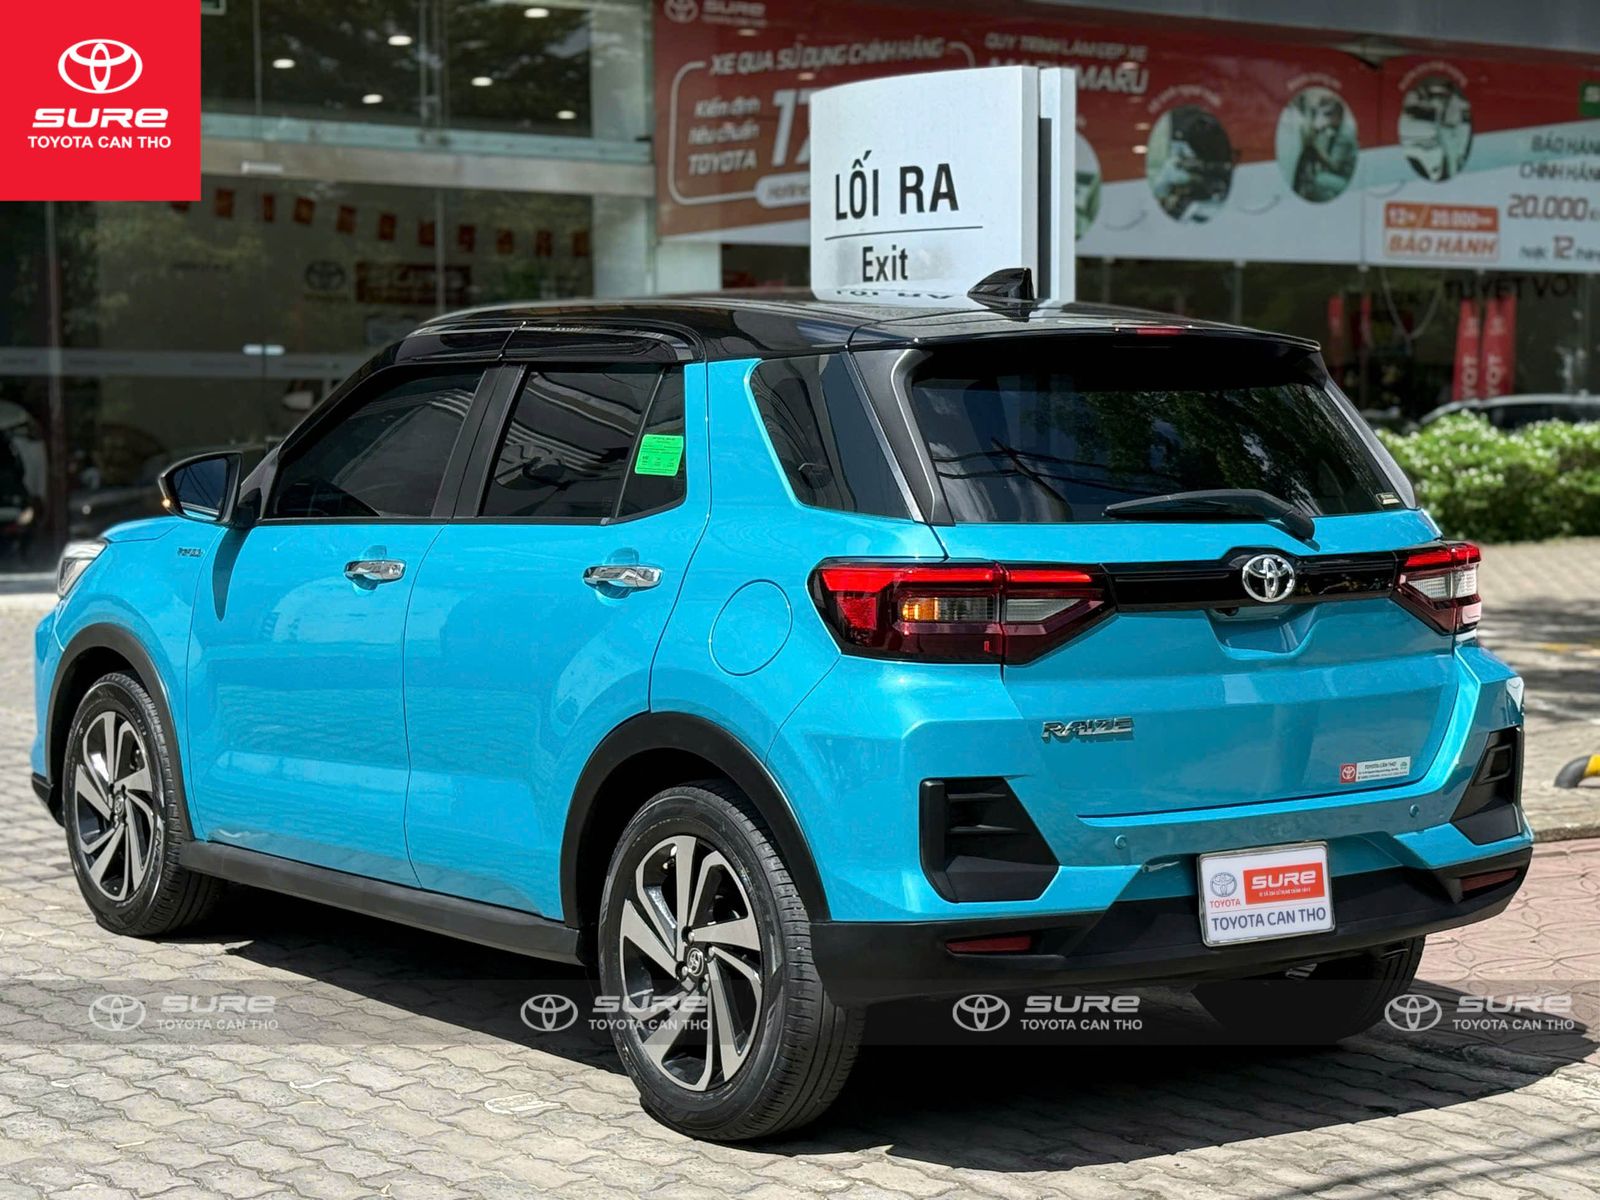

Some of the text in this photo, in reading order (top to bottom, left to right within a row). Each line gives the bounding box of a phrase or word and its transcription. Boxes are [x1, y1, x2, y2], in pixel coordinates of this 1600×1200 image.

[688, 149, 757, 176] TOYOTA
[835, 150, 959, 220] LỐI RA
[862, 244, 908, 282] Exit
[1042, 716, 1134, 738] RAIZE
[1210, 898, 1241, 908] TOYOTA
[1211, 907, 1326, 931] TOYOTA CAN THO
